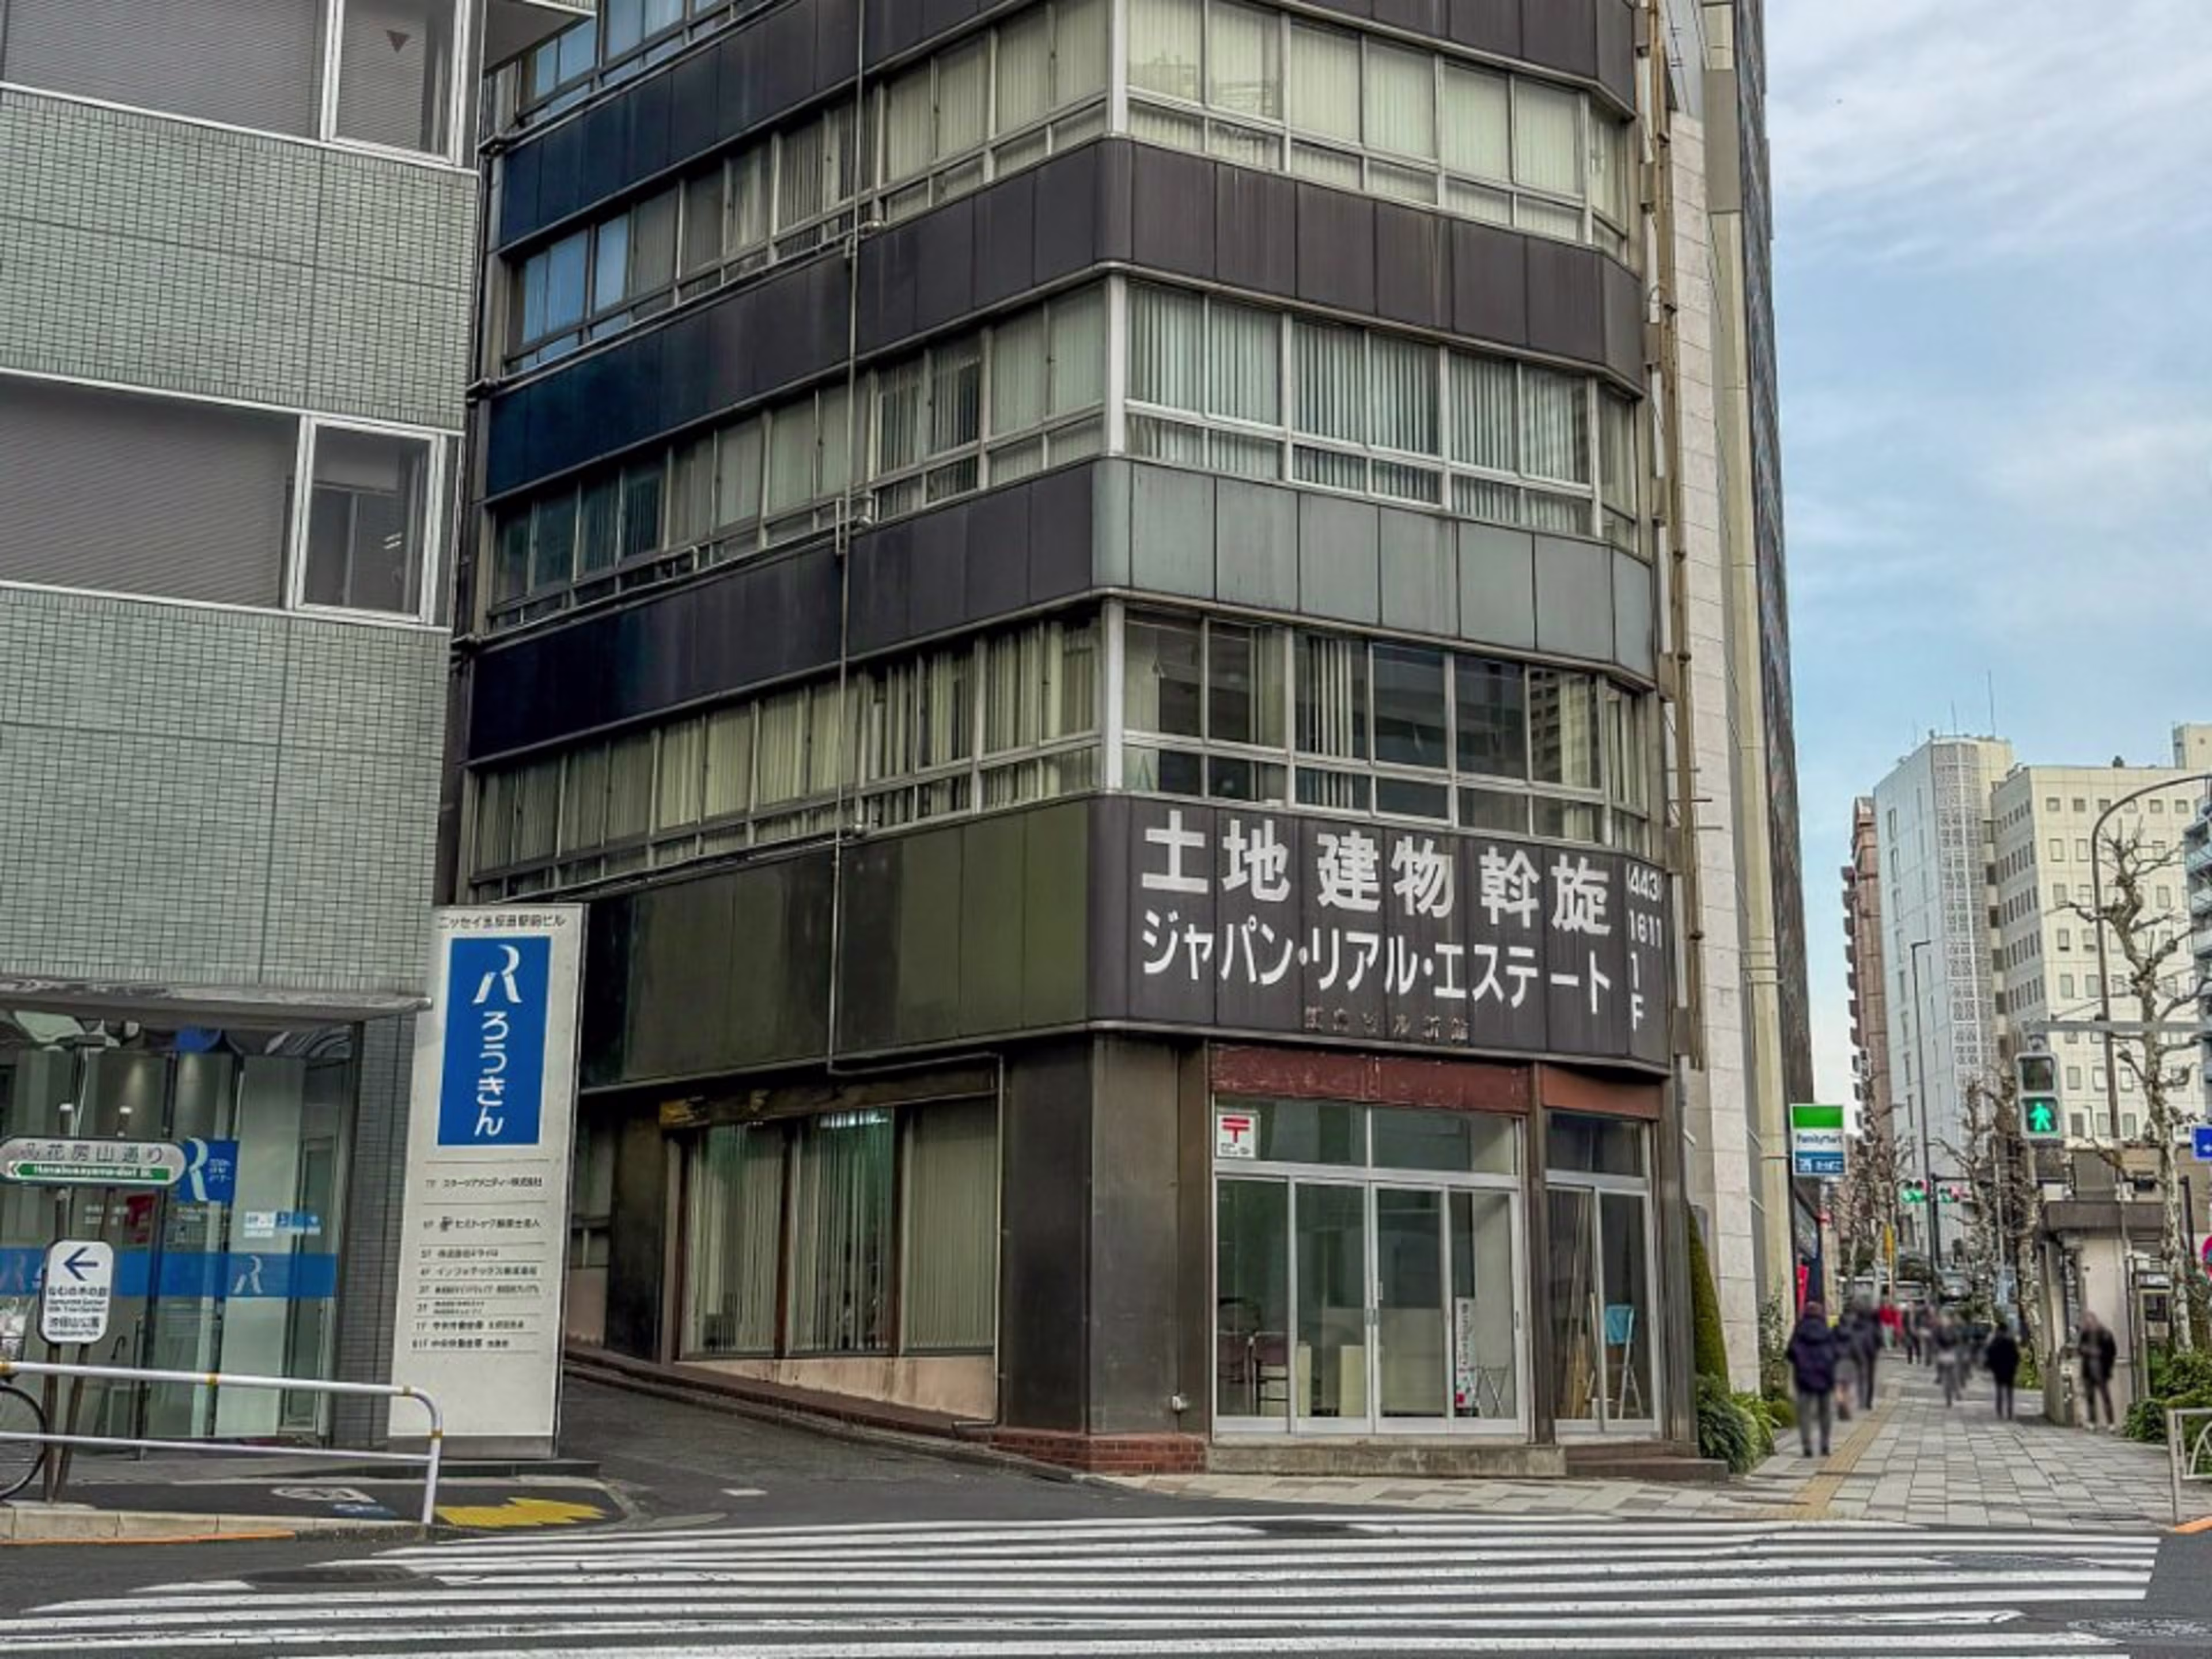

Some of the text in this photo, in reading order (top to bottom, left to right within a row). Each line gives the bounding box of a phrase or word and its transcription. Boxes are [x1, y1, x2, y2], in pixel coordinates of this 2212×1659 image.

[1142, 909, 1611, 1014] ジャパン・リアル・エステート
[474, 1011, 509, 1137] ろうきん
